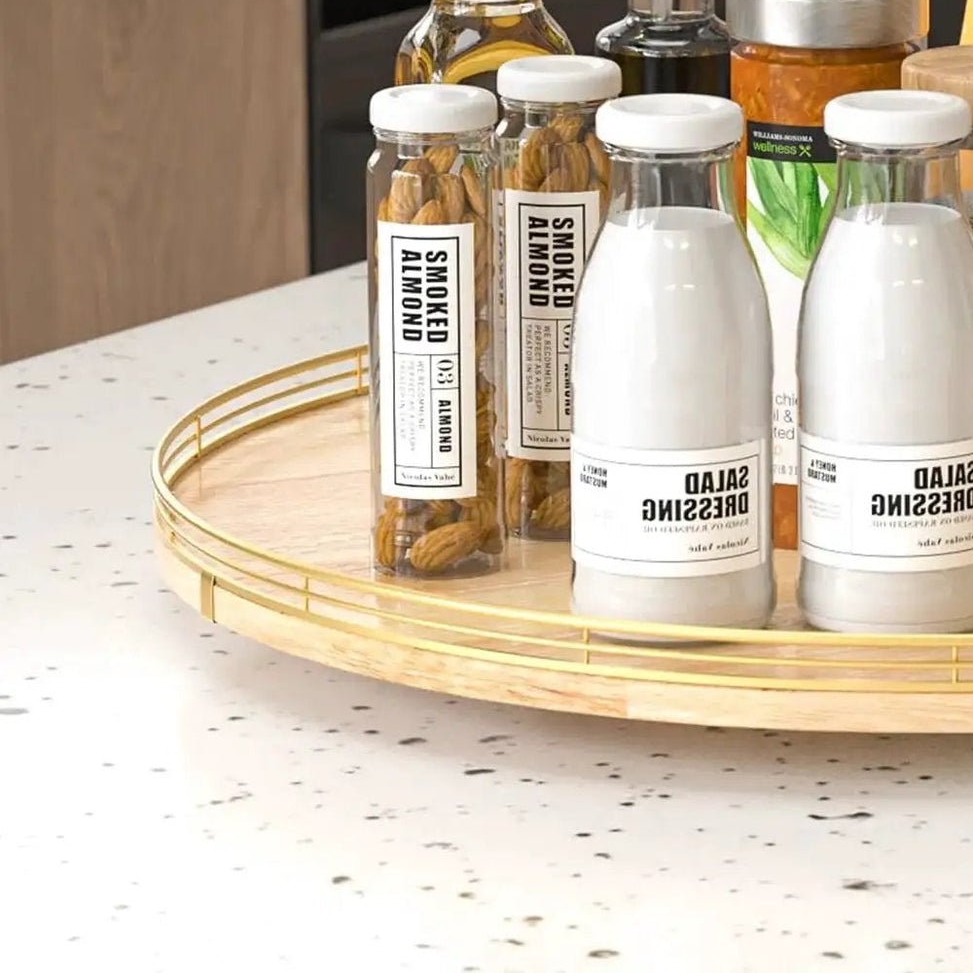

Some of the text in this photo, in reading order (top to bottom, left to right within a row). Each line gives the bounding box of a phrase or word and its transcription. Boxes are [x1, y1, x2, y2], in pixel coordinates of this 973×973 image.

[752, 130, 813, 142] WILLIAMS-SONOMA
[753, 141, 797, 155] wellness
[402, 249, 422, 342] ALMOND
[426, 251, 448, 343] SMOKED
[528, 216, 549, 306] ALMOND
[552, 217, 574, 308] SMOKED
[437, 359, 454, 453] 03 ALMOND
